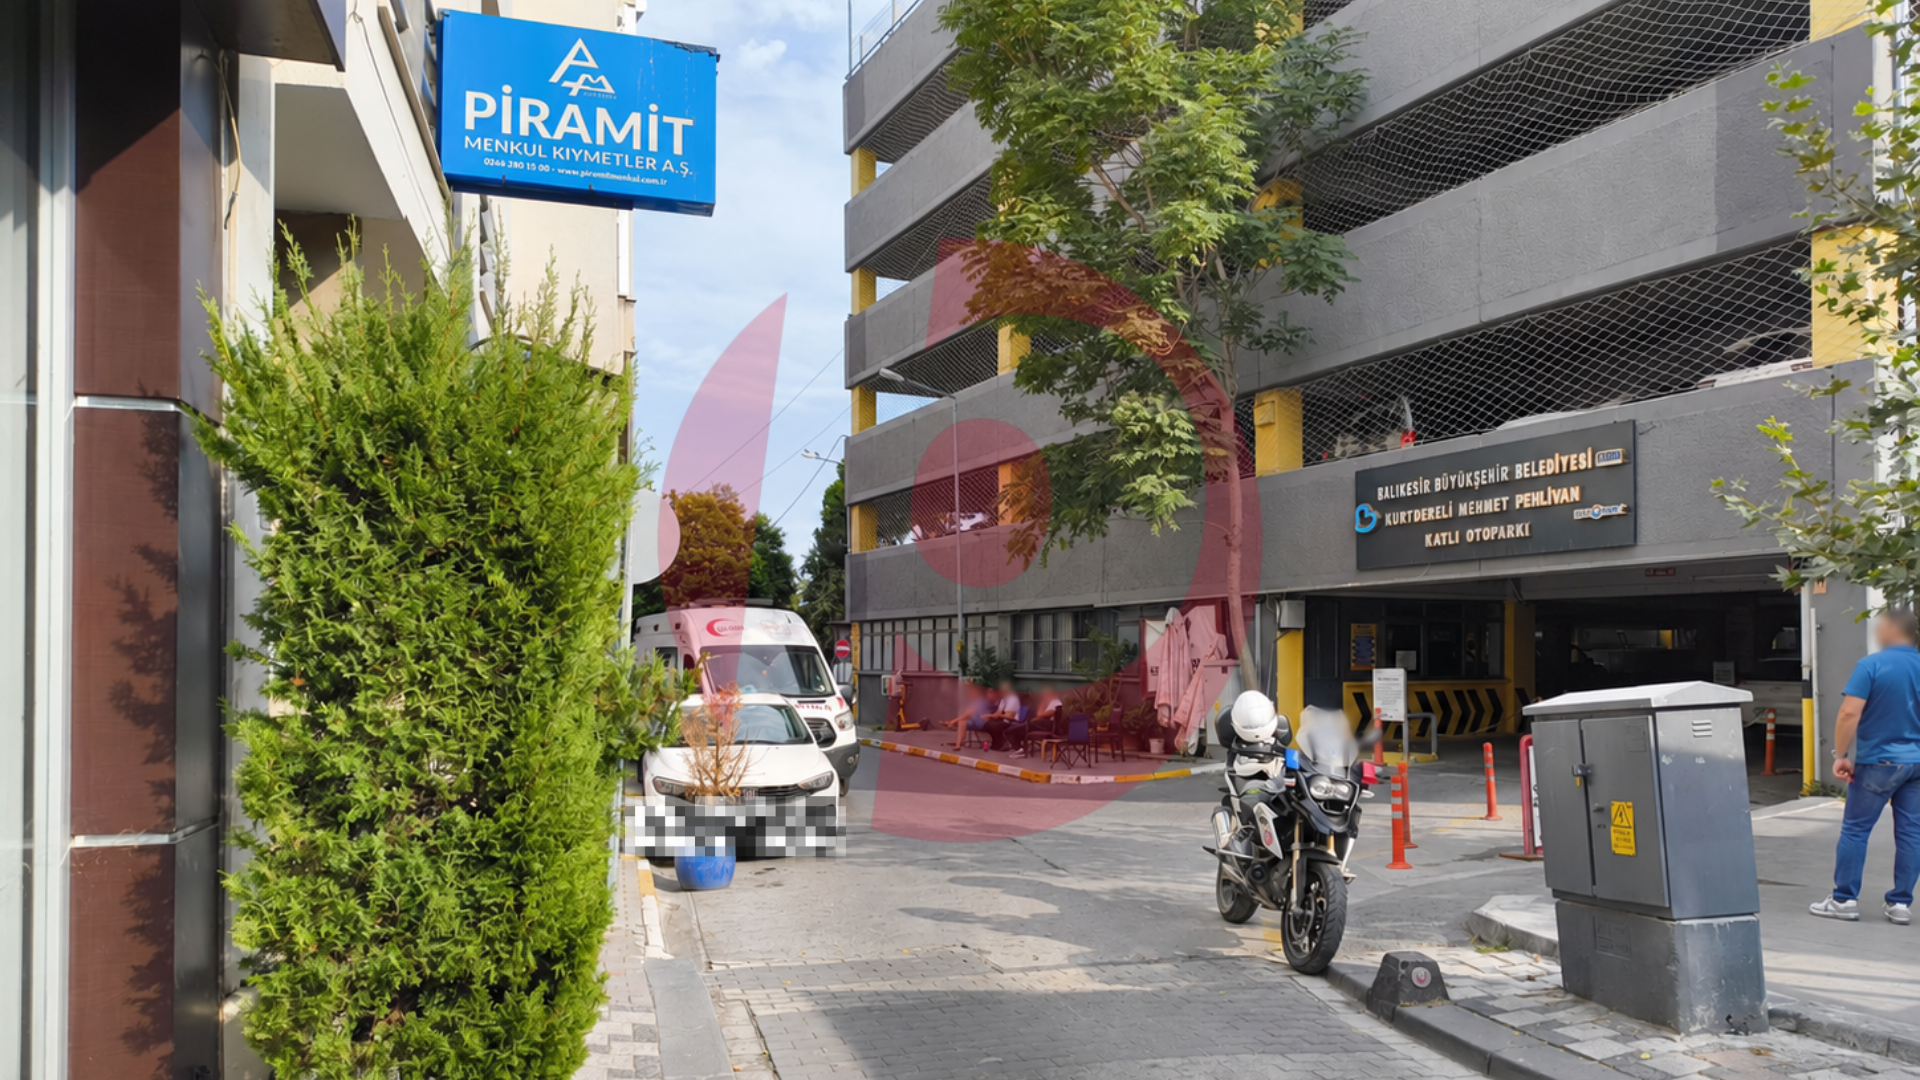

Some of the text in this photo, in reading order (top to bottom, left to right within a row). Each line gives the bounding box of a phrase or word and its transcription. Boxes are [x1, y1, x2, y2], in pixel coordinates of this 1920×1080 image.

[465, 85, 694, 155] PİRAMİT
[464, 136, 693, 177] MENKUL KIYMETLER A.Ş.
[538, 164, 550, 172] 00
[1377, 477, 1431, 501] BALIKESİR
[1434, 465, 1509, 491] BÜYÜKŞEHİR
[1515, 447, 1593, 479] BELEDİYESİ
[1385, 485, 1581, 526] KURTDERELİ MEHMET PEHLİVAN
[1425, 522, 1532, 548] KATLI OTOPARKI
